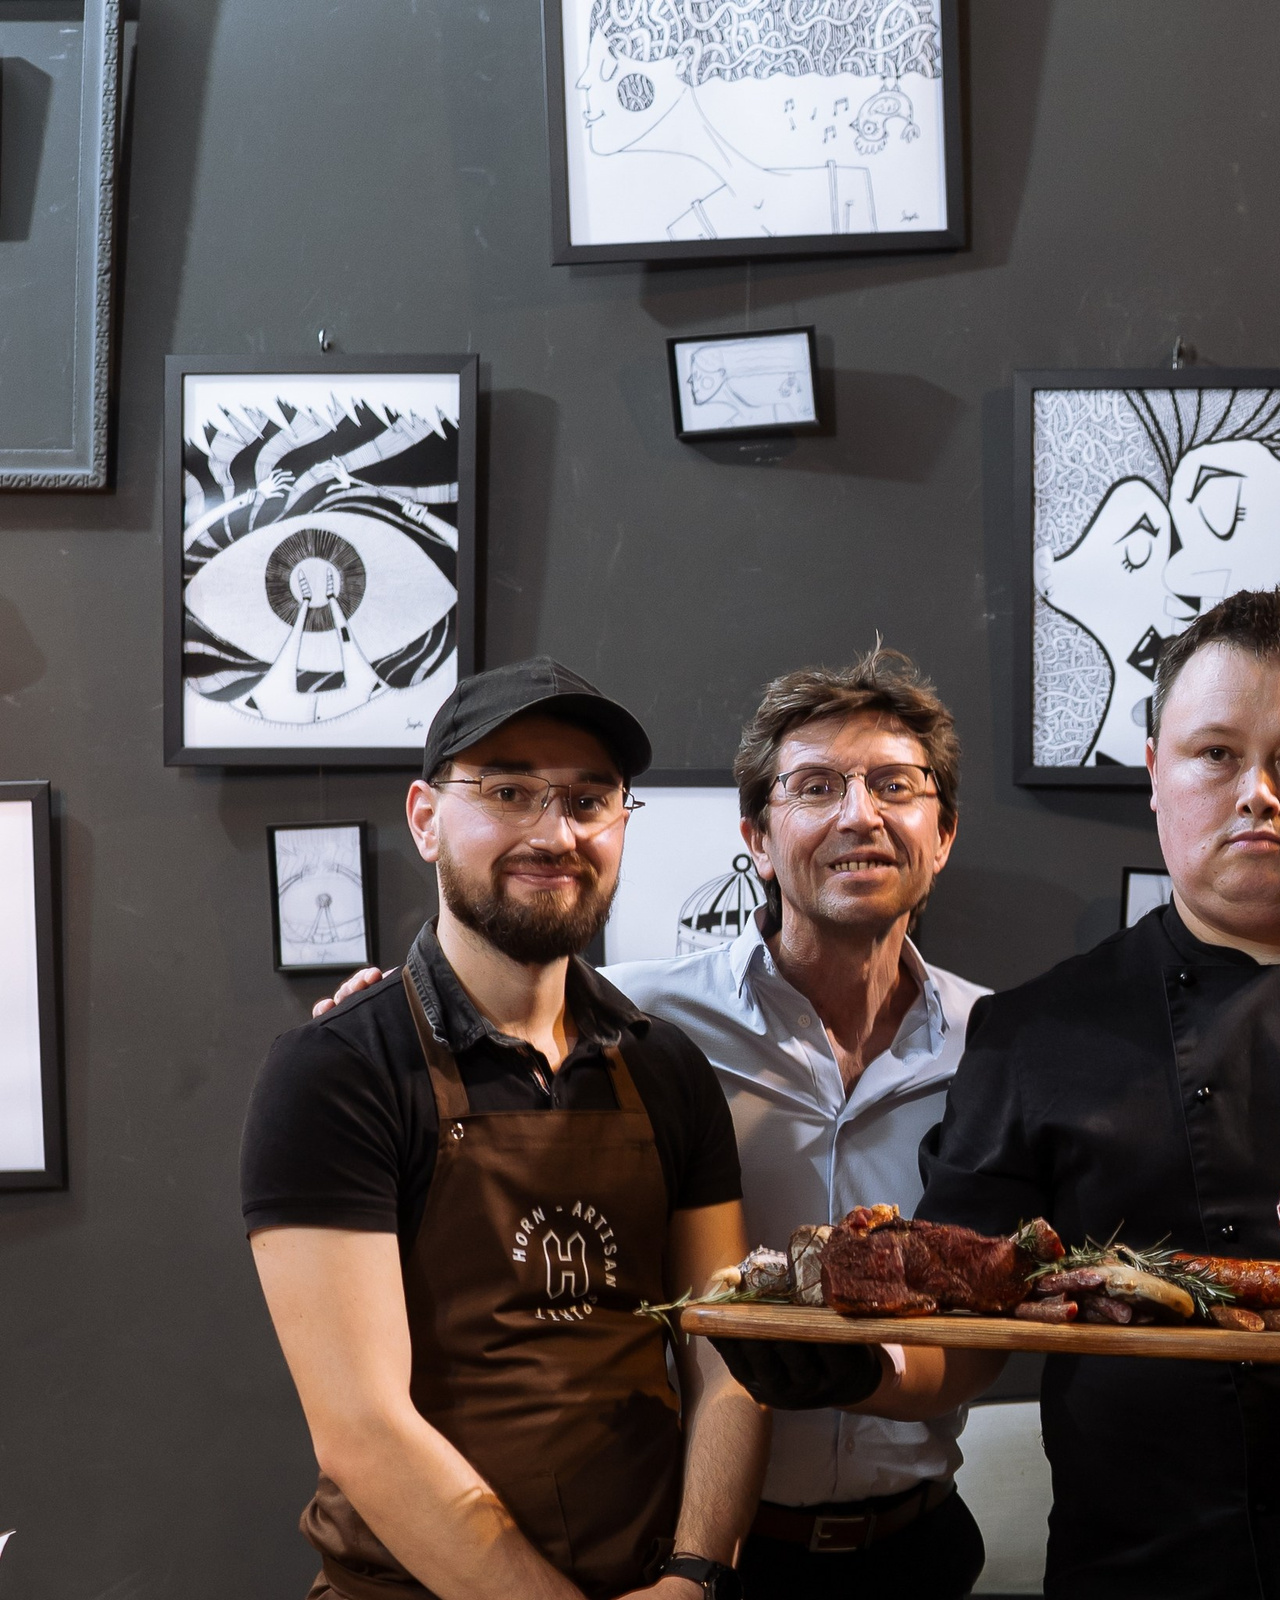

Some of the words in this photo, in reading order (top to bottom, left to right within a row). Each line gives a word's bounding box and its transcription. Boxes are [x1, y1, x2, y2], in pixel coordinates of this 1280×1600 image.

[512, 1205, 546, 1263] HORN
[571, 1200, 618, 1288] ARTISAN
[535, 1295, 598, 1321] SPIRIT
